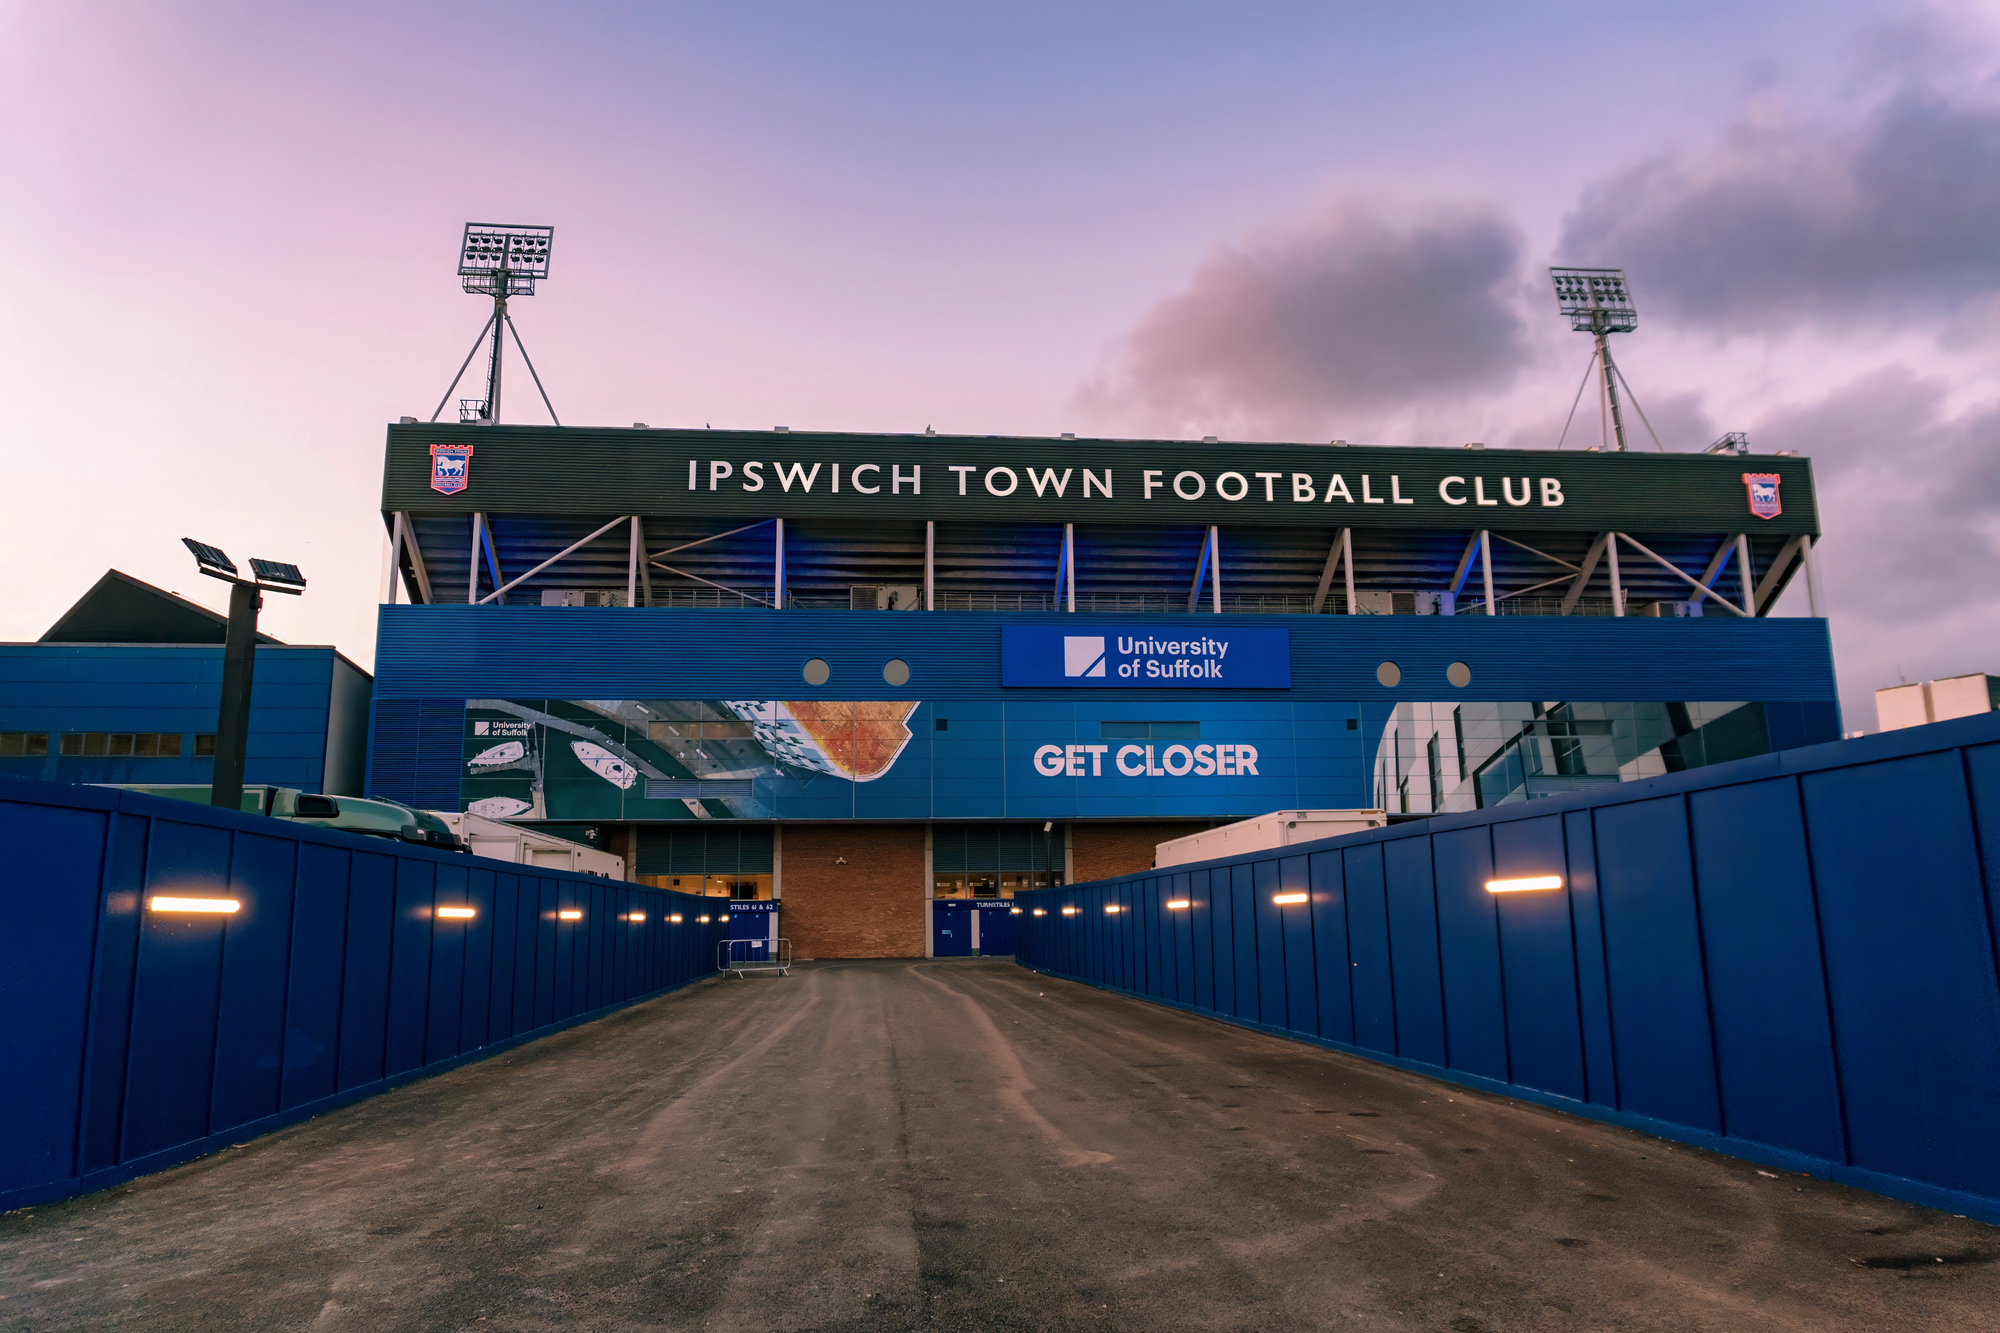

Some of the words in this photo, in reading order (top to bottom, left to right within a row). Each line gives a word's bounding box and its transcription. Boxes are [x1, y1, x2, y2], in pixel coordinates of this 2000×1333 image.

[689, 460, 921, 495] IPSWICH
[949, 466, 1112, 499] TOWN
[1144, 470, 1414, 505] FOOTBALL
[1439, 476, 1565, 507] CLUB
[1118, 636, 1229, 659] University
[1118, 659, 1141, 678] of
[1146, 659, 1224, 678] Suffolk
[492, 721, 531, 730] University
[1033, 744, 1108, 777] GET
[1116, 744, 1260, 777] CLOSER
